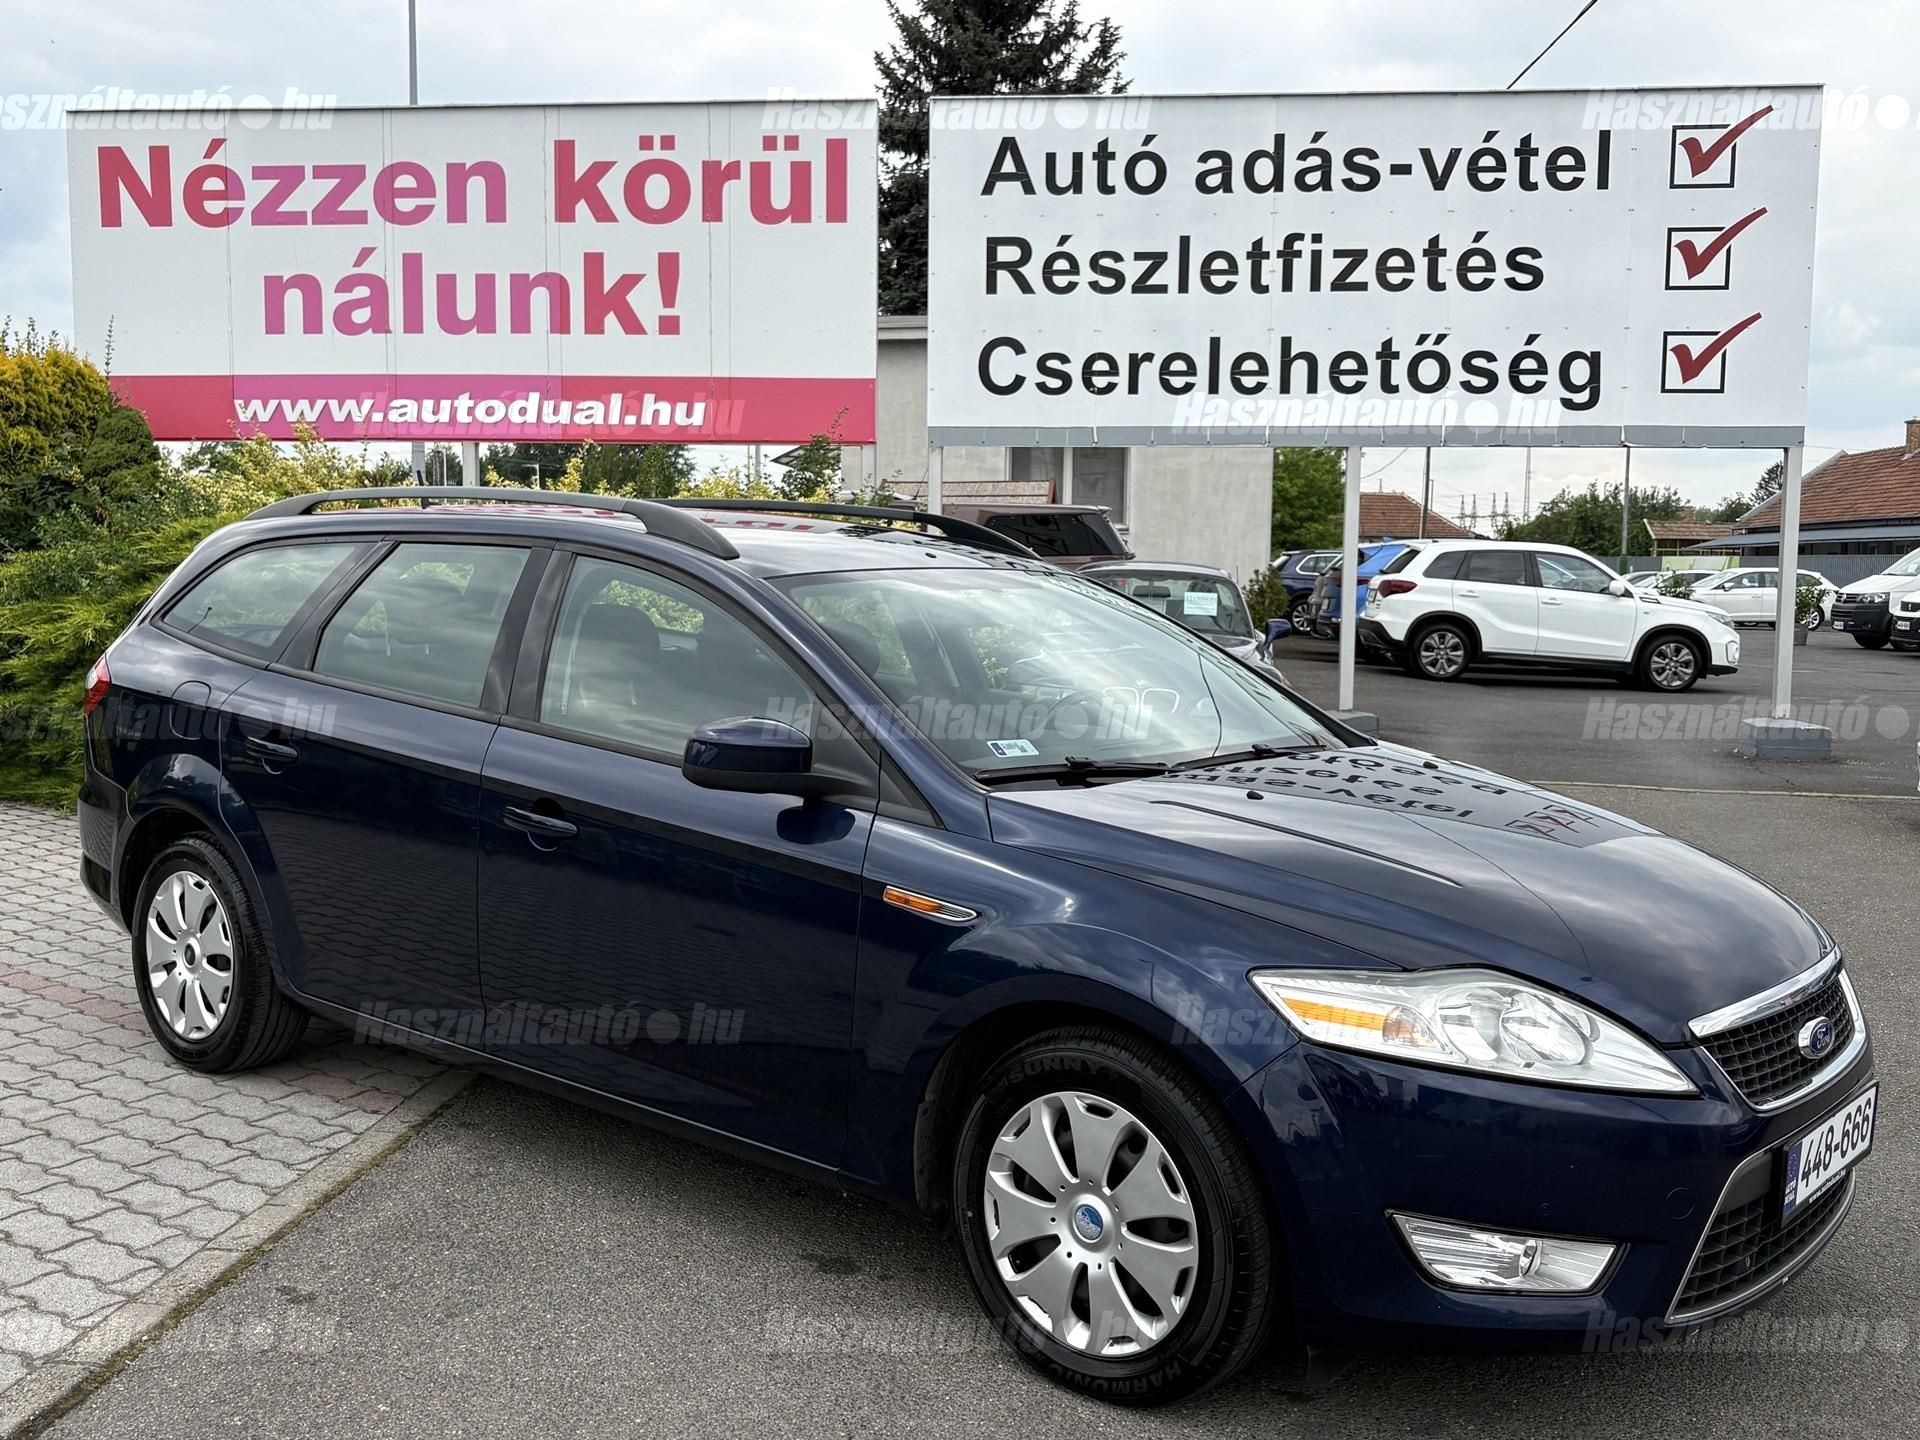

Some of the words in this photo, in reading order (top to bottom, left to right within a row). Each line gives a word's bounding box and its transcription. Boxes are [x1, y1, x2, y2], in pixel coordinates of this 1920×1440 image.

[98, 138, 508, 228] Nézzen
[553, 134, 850, 226] körül
[980, 133, 1168, 197] Autó
[1194, 129, 1612, 195] adás-vétel
[263, 246, 682, 337] nálunk!
[985, 230, 1546, 296] Részletfizetés
[233, 390, 707, 428] www.autodual.hu
[977, 332, 1603, 412] Cserelehetőség
[1800, 1097, 1872, 1188] 448-666
